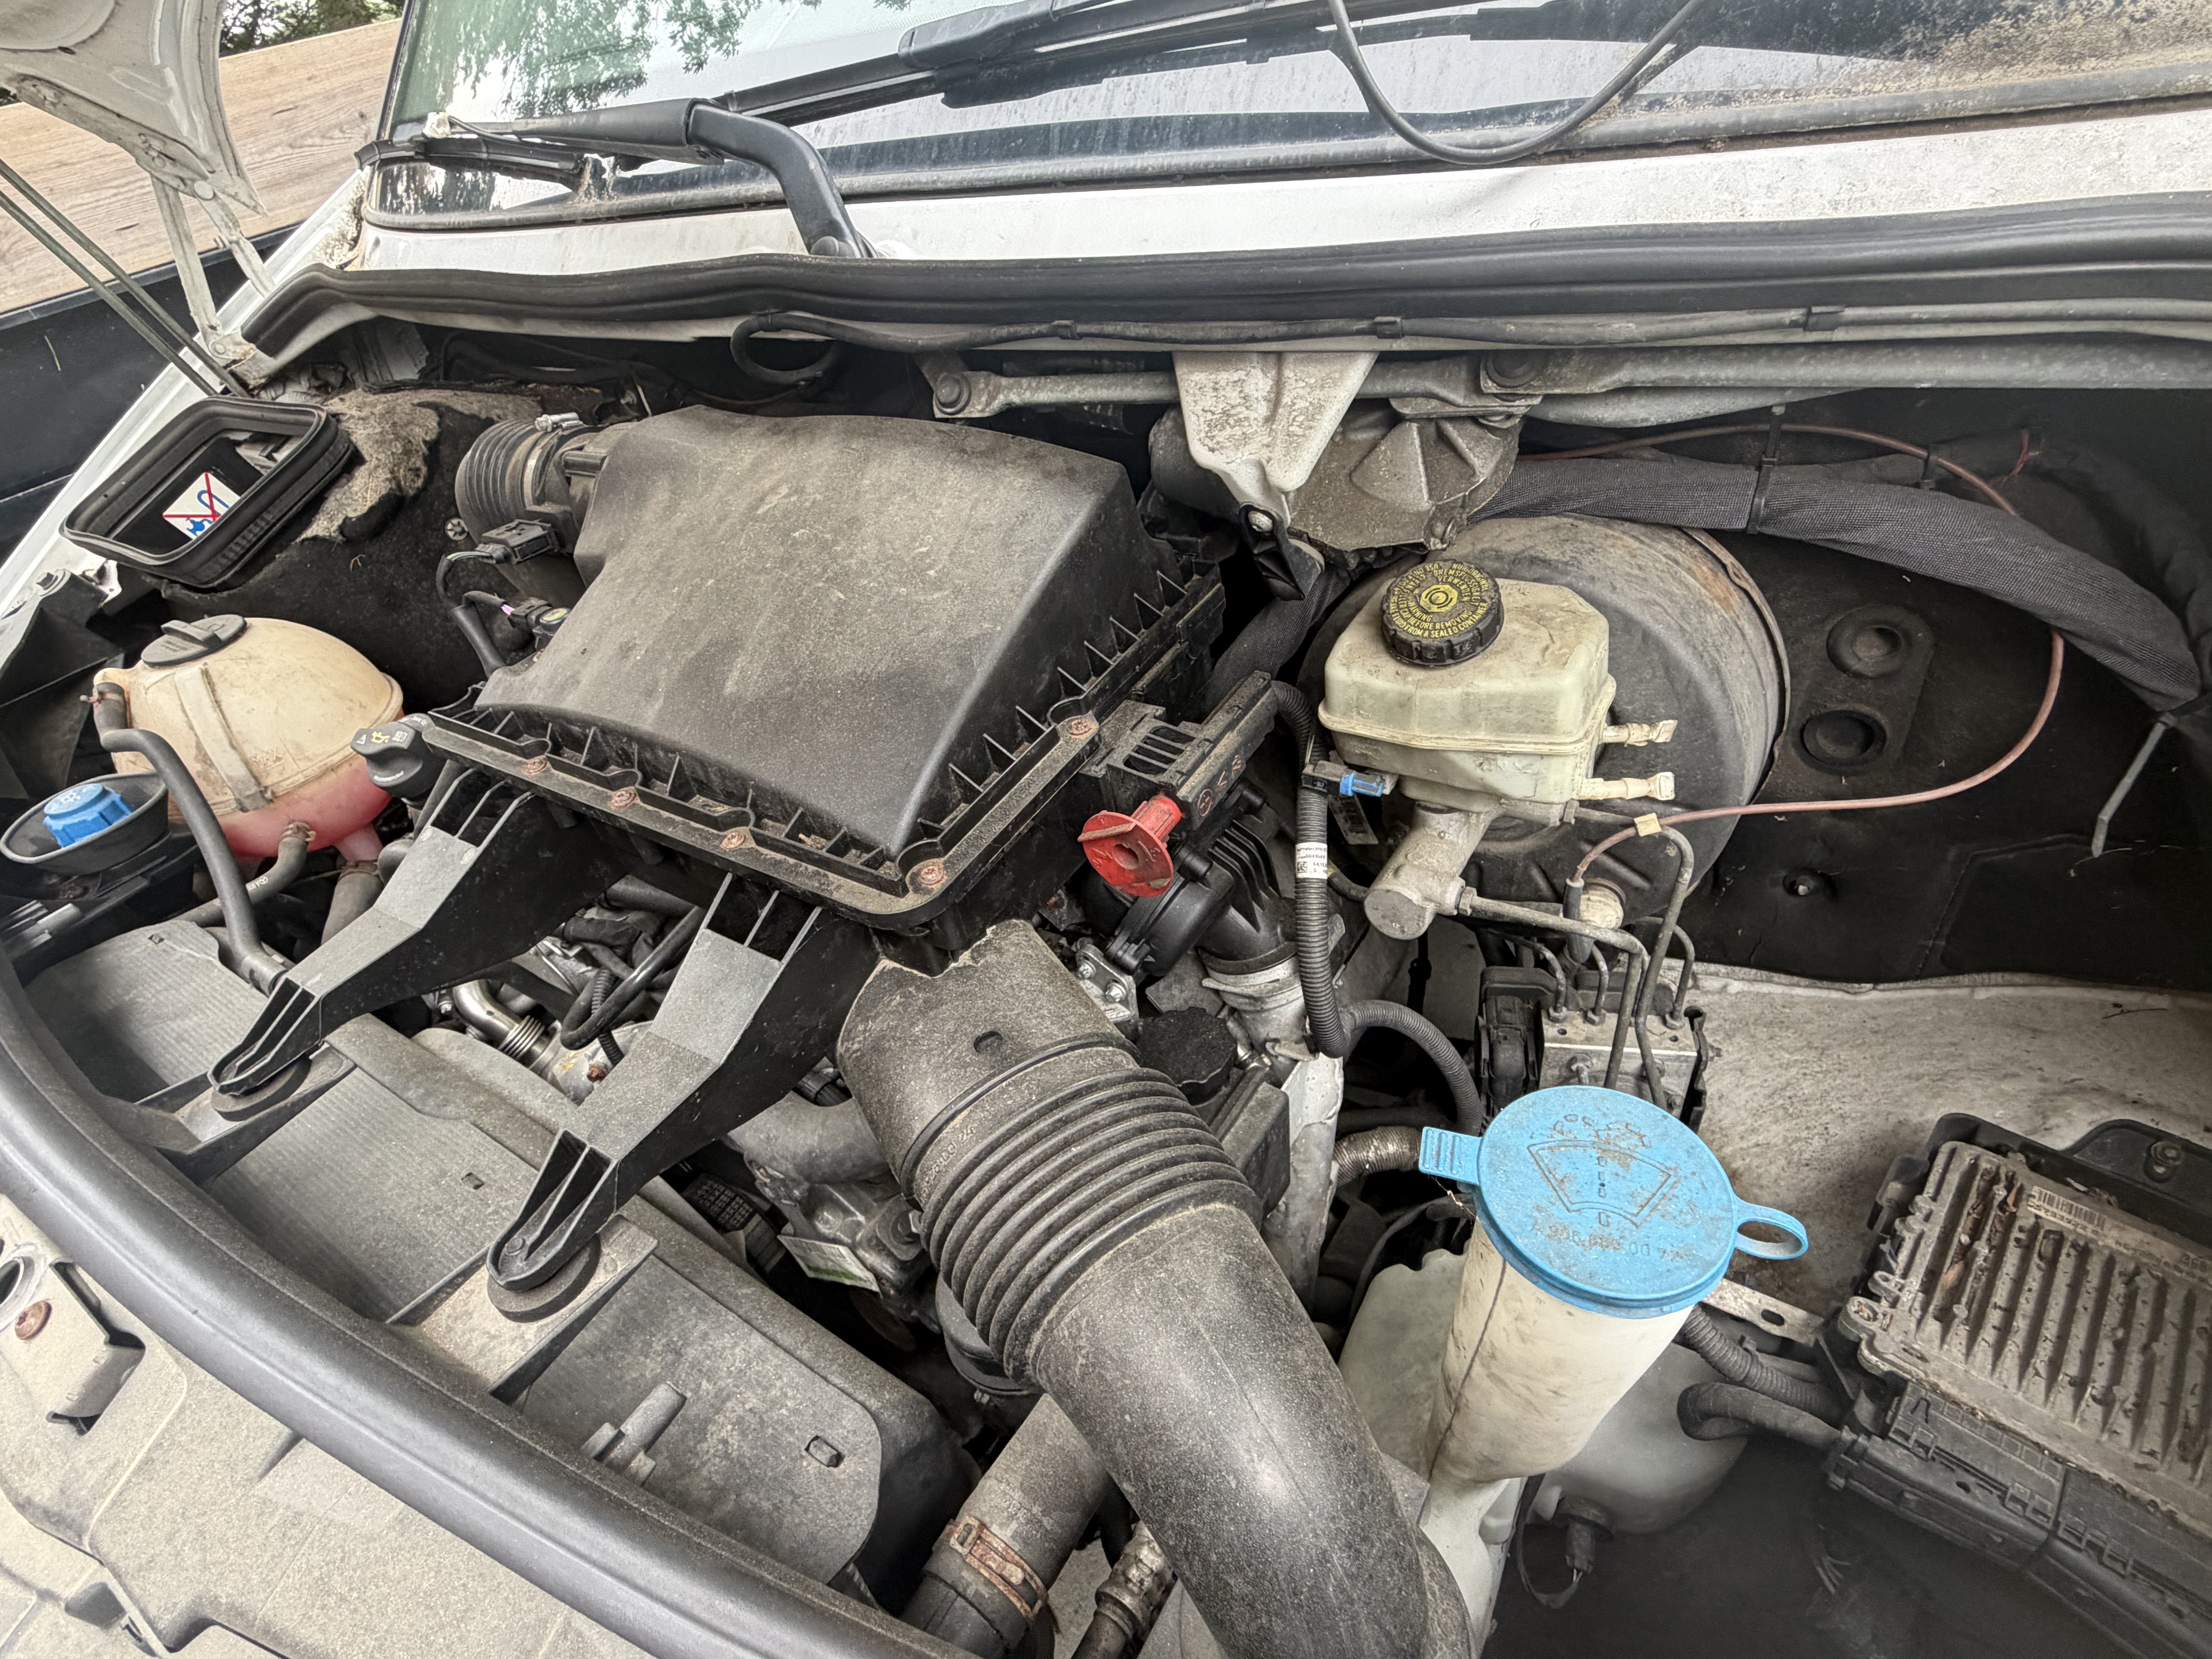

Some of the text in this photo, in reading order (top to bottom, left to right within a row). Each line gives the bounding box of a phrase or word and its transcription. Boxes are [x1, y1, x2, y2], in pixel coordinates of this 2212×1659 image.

[1424, 563, 1439, 572] USE
[1437, 575, 1471, 601] VERWENDEN
[1400, 608, 1412, 618] CAP
[1407, 617, 1434, 630] BEFORE
[1436, 610, 1472, 630] REMOVING
[1408, 601, 1433, 622] WARNING
[1458, 602, 1489, 631] CONTAINER
[1403, 624, 1424, 636] FROM
[1431, 627, 1459, 638] SEALED
[251, 747, 276, 765] MAX
